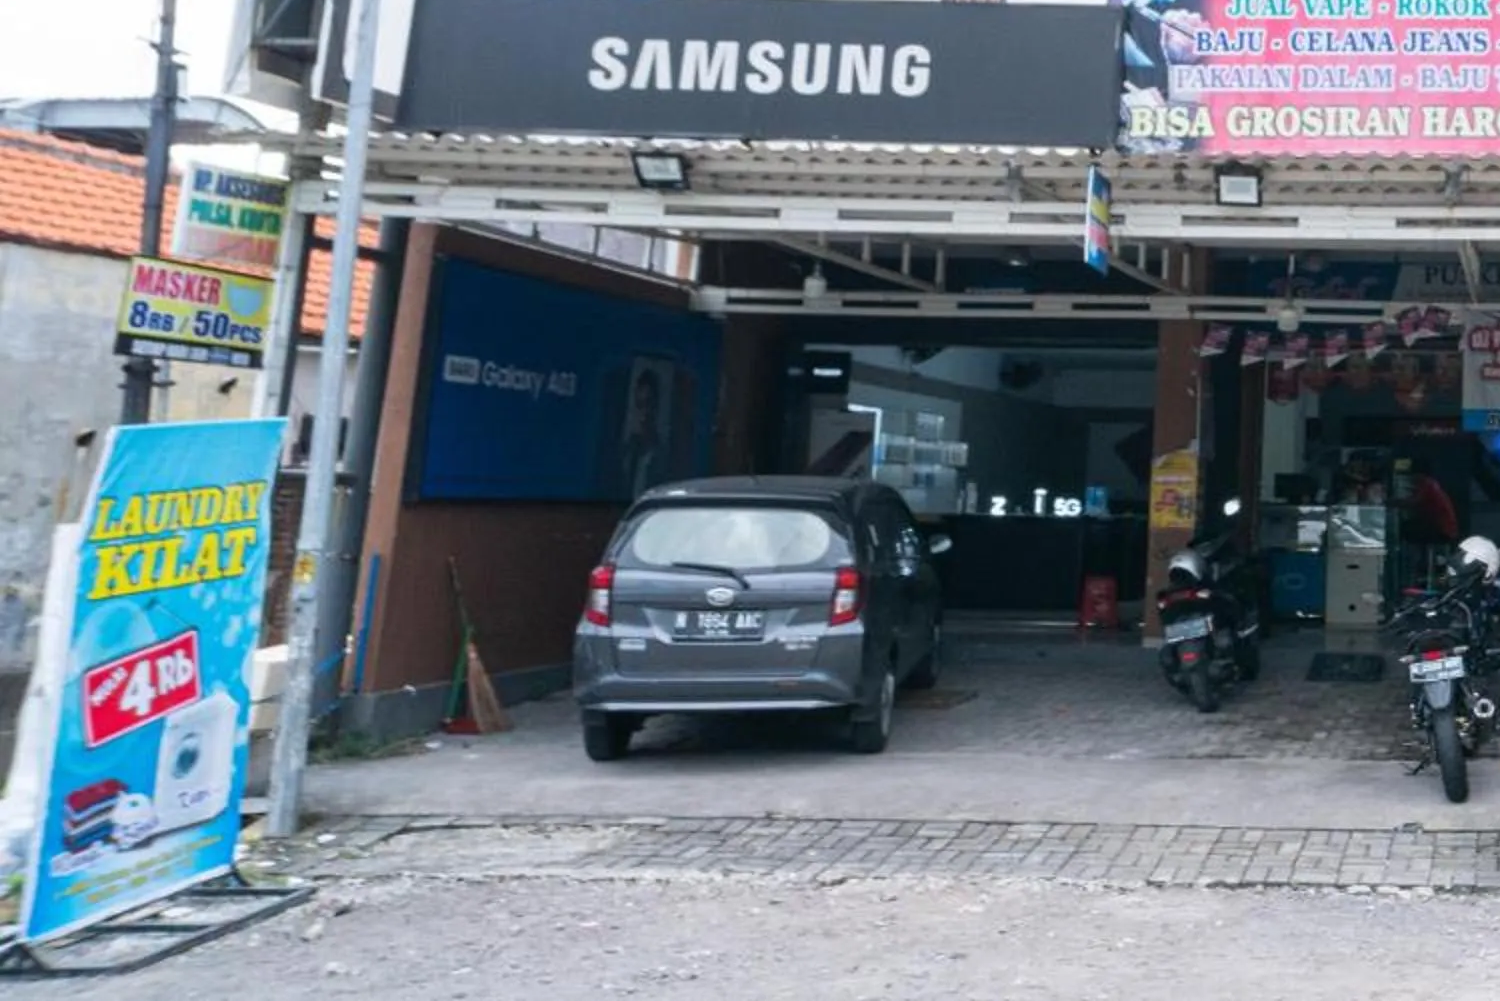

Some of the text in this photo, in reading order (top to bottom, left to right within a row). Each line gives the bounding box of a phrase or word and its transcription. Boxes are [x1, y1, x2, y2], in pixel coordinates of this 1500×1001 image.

[1194, 29, 1264, 58] BAJU
[1289, 29, 1396, 55] CELANA
[1402, 29, 1490, 56] JEANS
[588, 36, 932, 98] SAMSUNG
[1174, 65, 1292, 91] PAKAIAN
[1300, 65, 1394, 91] DALAM
[1420, 65, 1491, 93] BAJU
[1129, 107, 1214, 140] BISA
[1227, 107, 1405, 139] GROSIRAN
[133, 265, 221, 305] MASKER
[95, 482, 266, 543] LAUNDRY
[88, 527, 256, 601] KILAT
